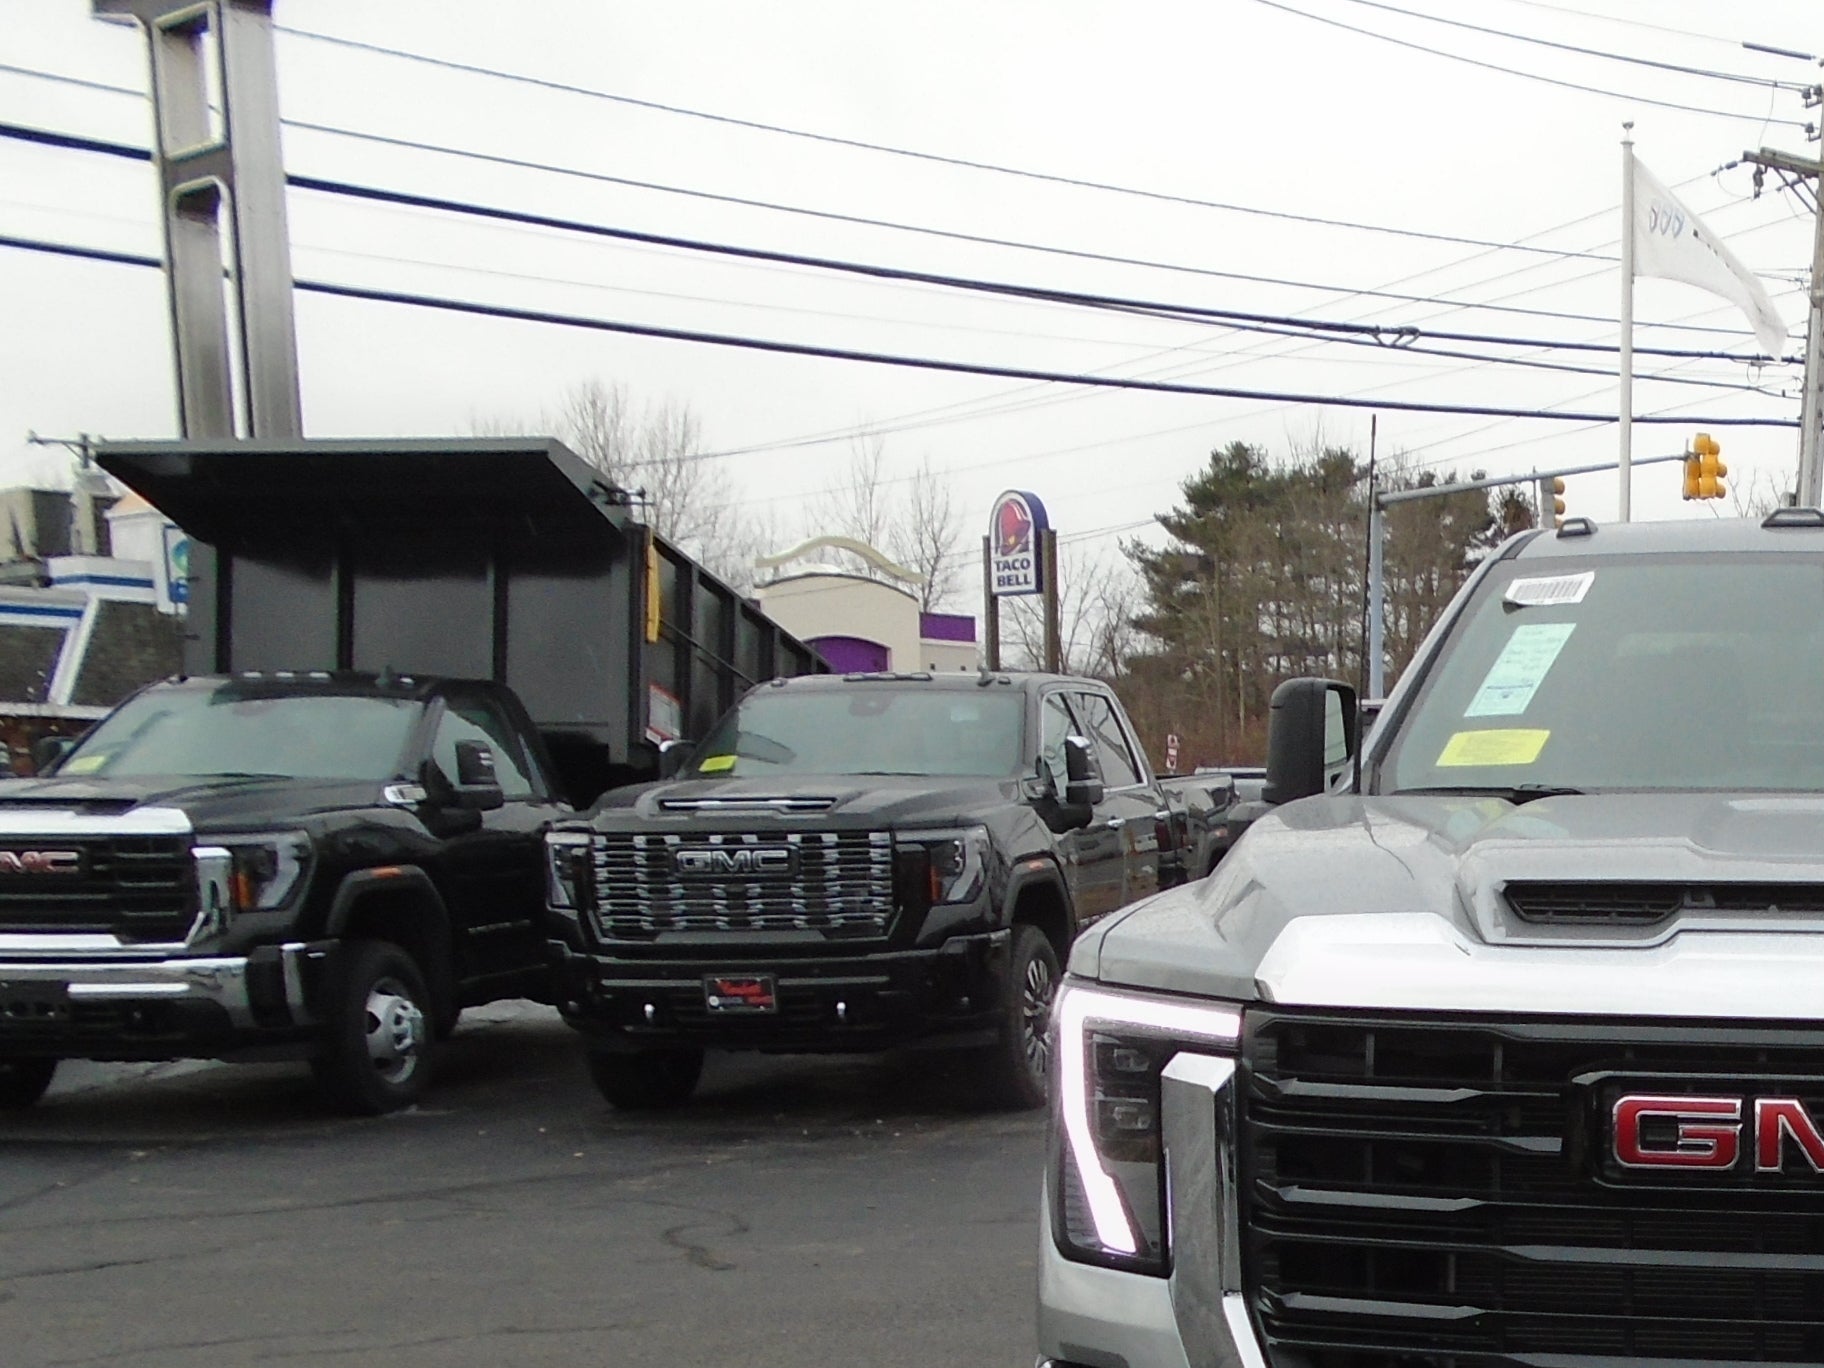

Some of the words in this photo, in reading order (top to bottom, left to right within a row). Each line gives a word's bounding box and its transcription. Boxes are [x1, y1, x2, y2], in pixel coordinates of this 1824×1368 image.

[994, 558, 1031, 572] TACO
[997, 573, 1032, 587] BELL
[0, 851, 79, 873] MC
[676, 850, 789, 873] GMC
